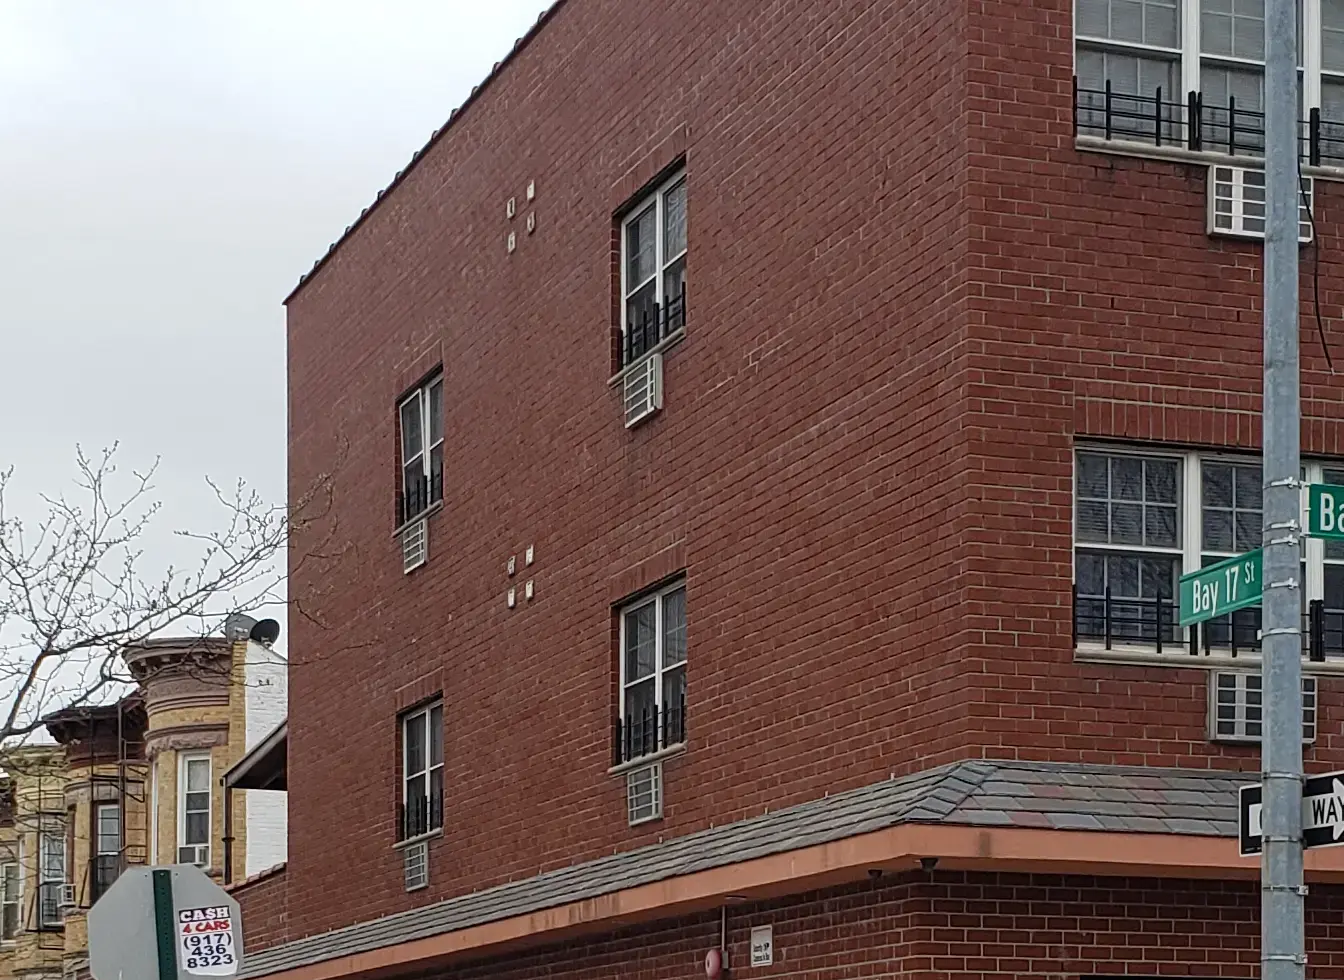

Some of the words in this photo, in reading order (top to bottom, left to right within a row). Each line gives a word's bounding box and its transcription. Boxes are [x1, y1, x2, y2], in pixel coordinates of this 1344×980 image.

[1192, 579, 1219, 617] Bay
[1225, 565, 1239, 604] 17
[1244, 560, 1255, 584] St
[182, 923, 192, 933] 4
[195, 919, 230, 932] CARS
[183, 932, 232, 950] (917)
[191, 943, 227, 957] 436
[187, 953, 234, 969] 8323
